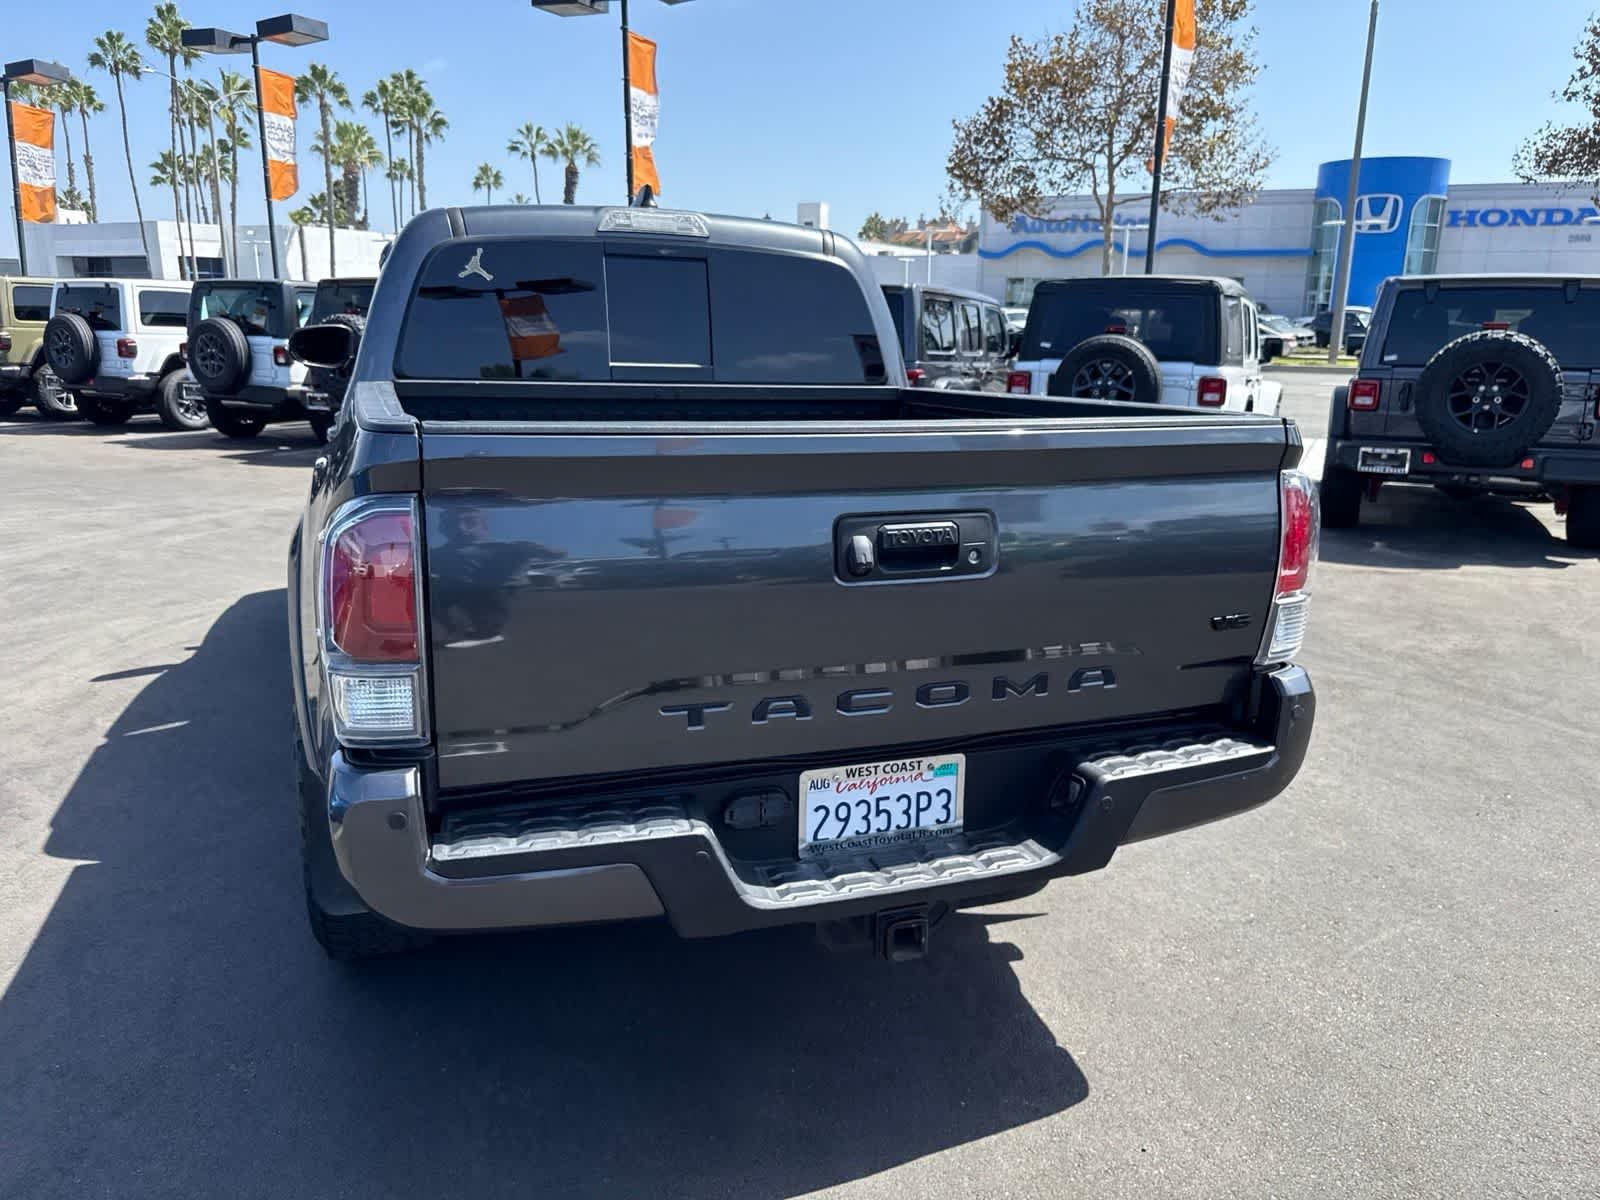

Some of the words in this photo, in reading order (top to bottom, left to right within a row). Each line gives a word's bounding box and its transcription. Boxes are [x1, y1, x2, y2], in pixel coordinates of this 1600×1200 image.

[1446, 207, 1600, 227] HONDA
[886, 528, 956, 544] TOYOTA
[658, 665, 1117, 731] TACOMA
[845, 765, 880, 778] WEST
[883, 760, 923, 775] COAST
[809, 778, 830, 791] AUG
[835, 772, 933, 795] California
[813, 788, 952, 842] 29353P3
